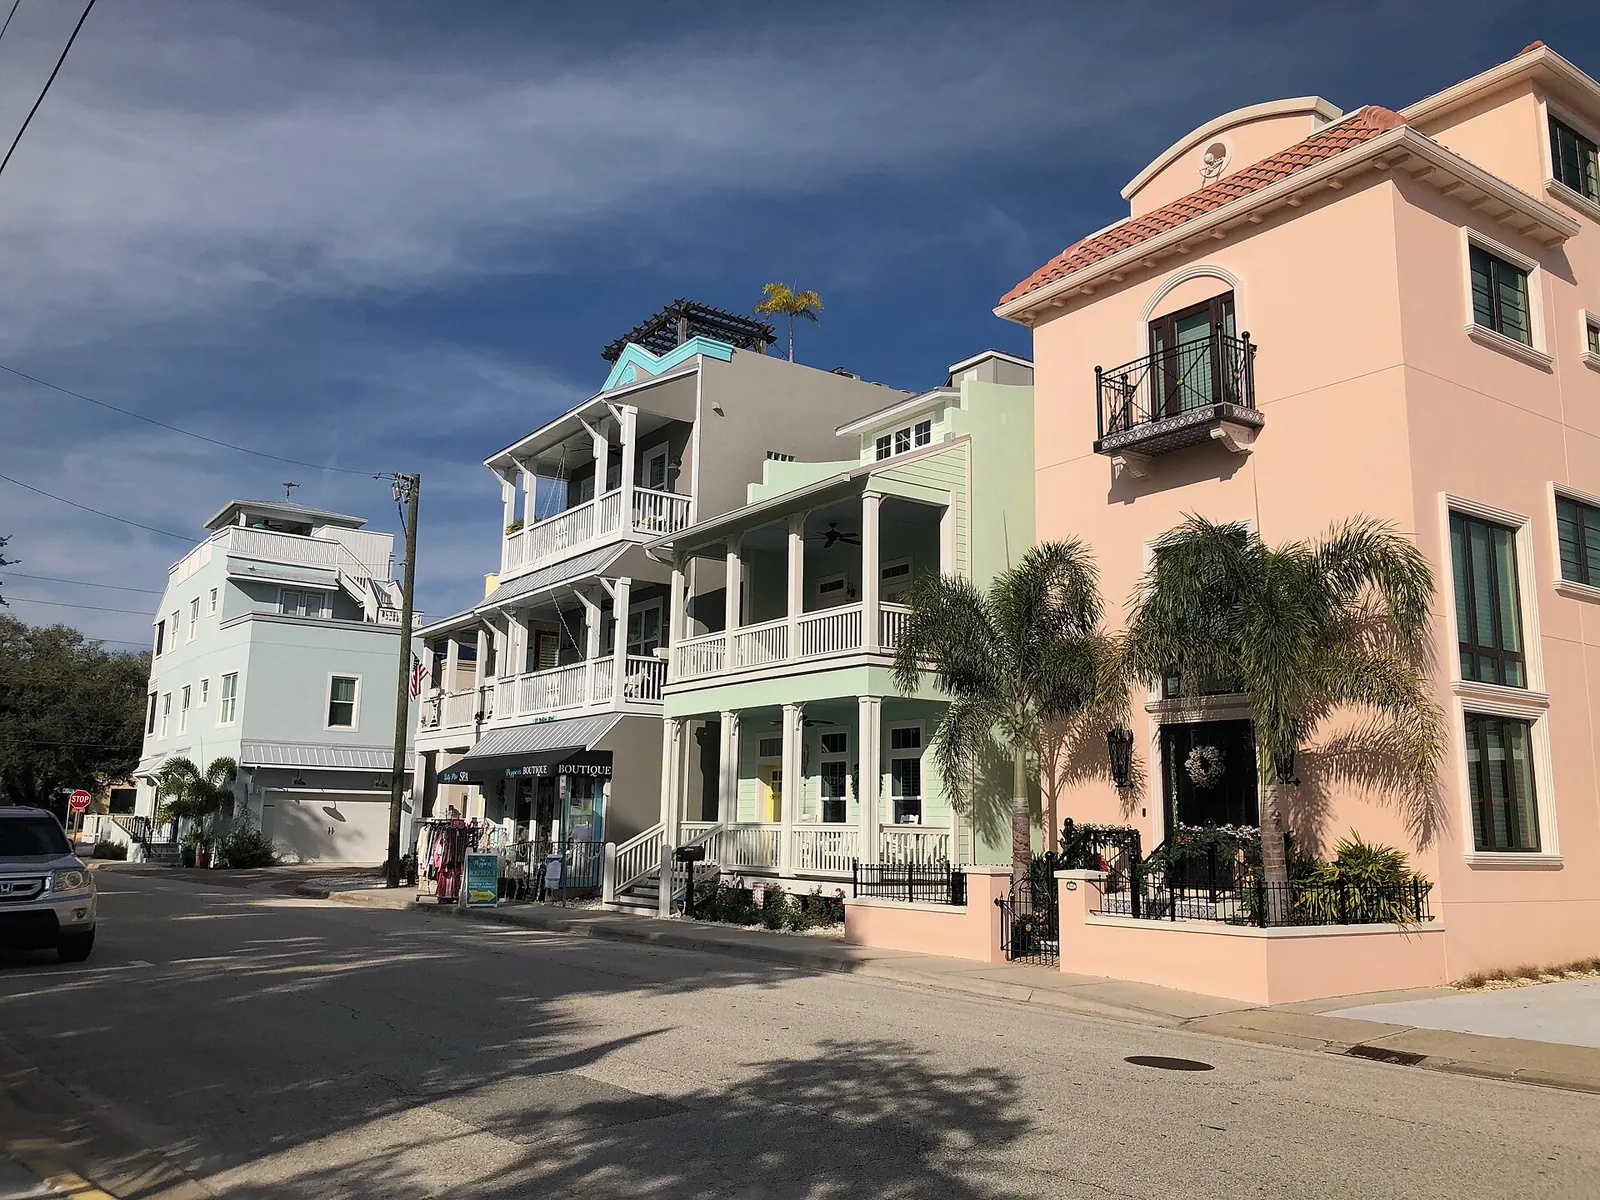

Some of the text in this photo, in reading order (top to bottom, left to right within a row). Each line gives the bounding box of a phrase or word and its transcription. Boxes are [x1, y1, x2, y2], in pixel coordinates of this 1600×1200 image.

[523, 765, 548, 777] BOUTIQUE
[558, 764, 612, 777] BOUTIQUE
[71, 795, 90, 803] STOP
